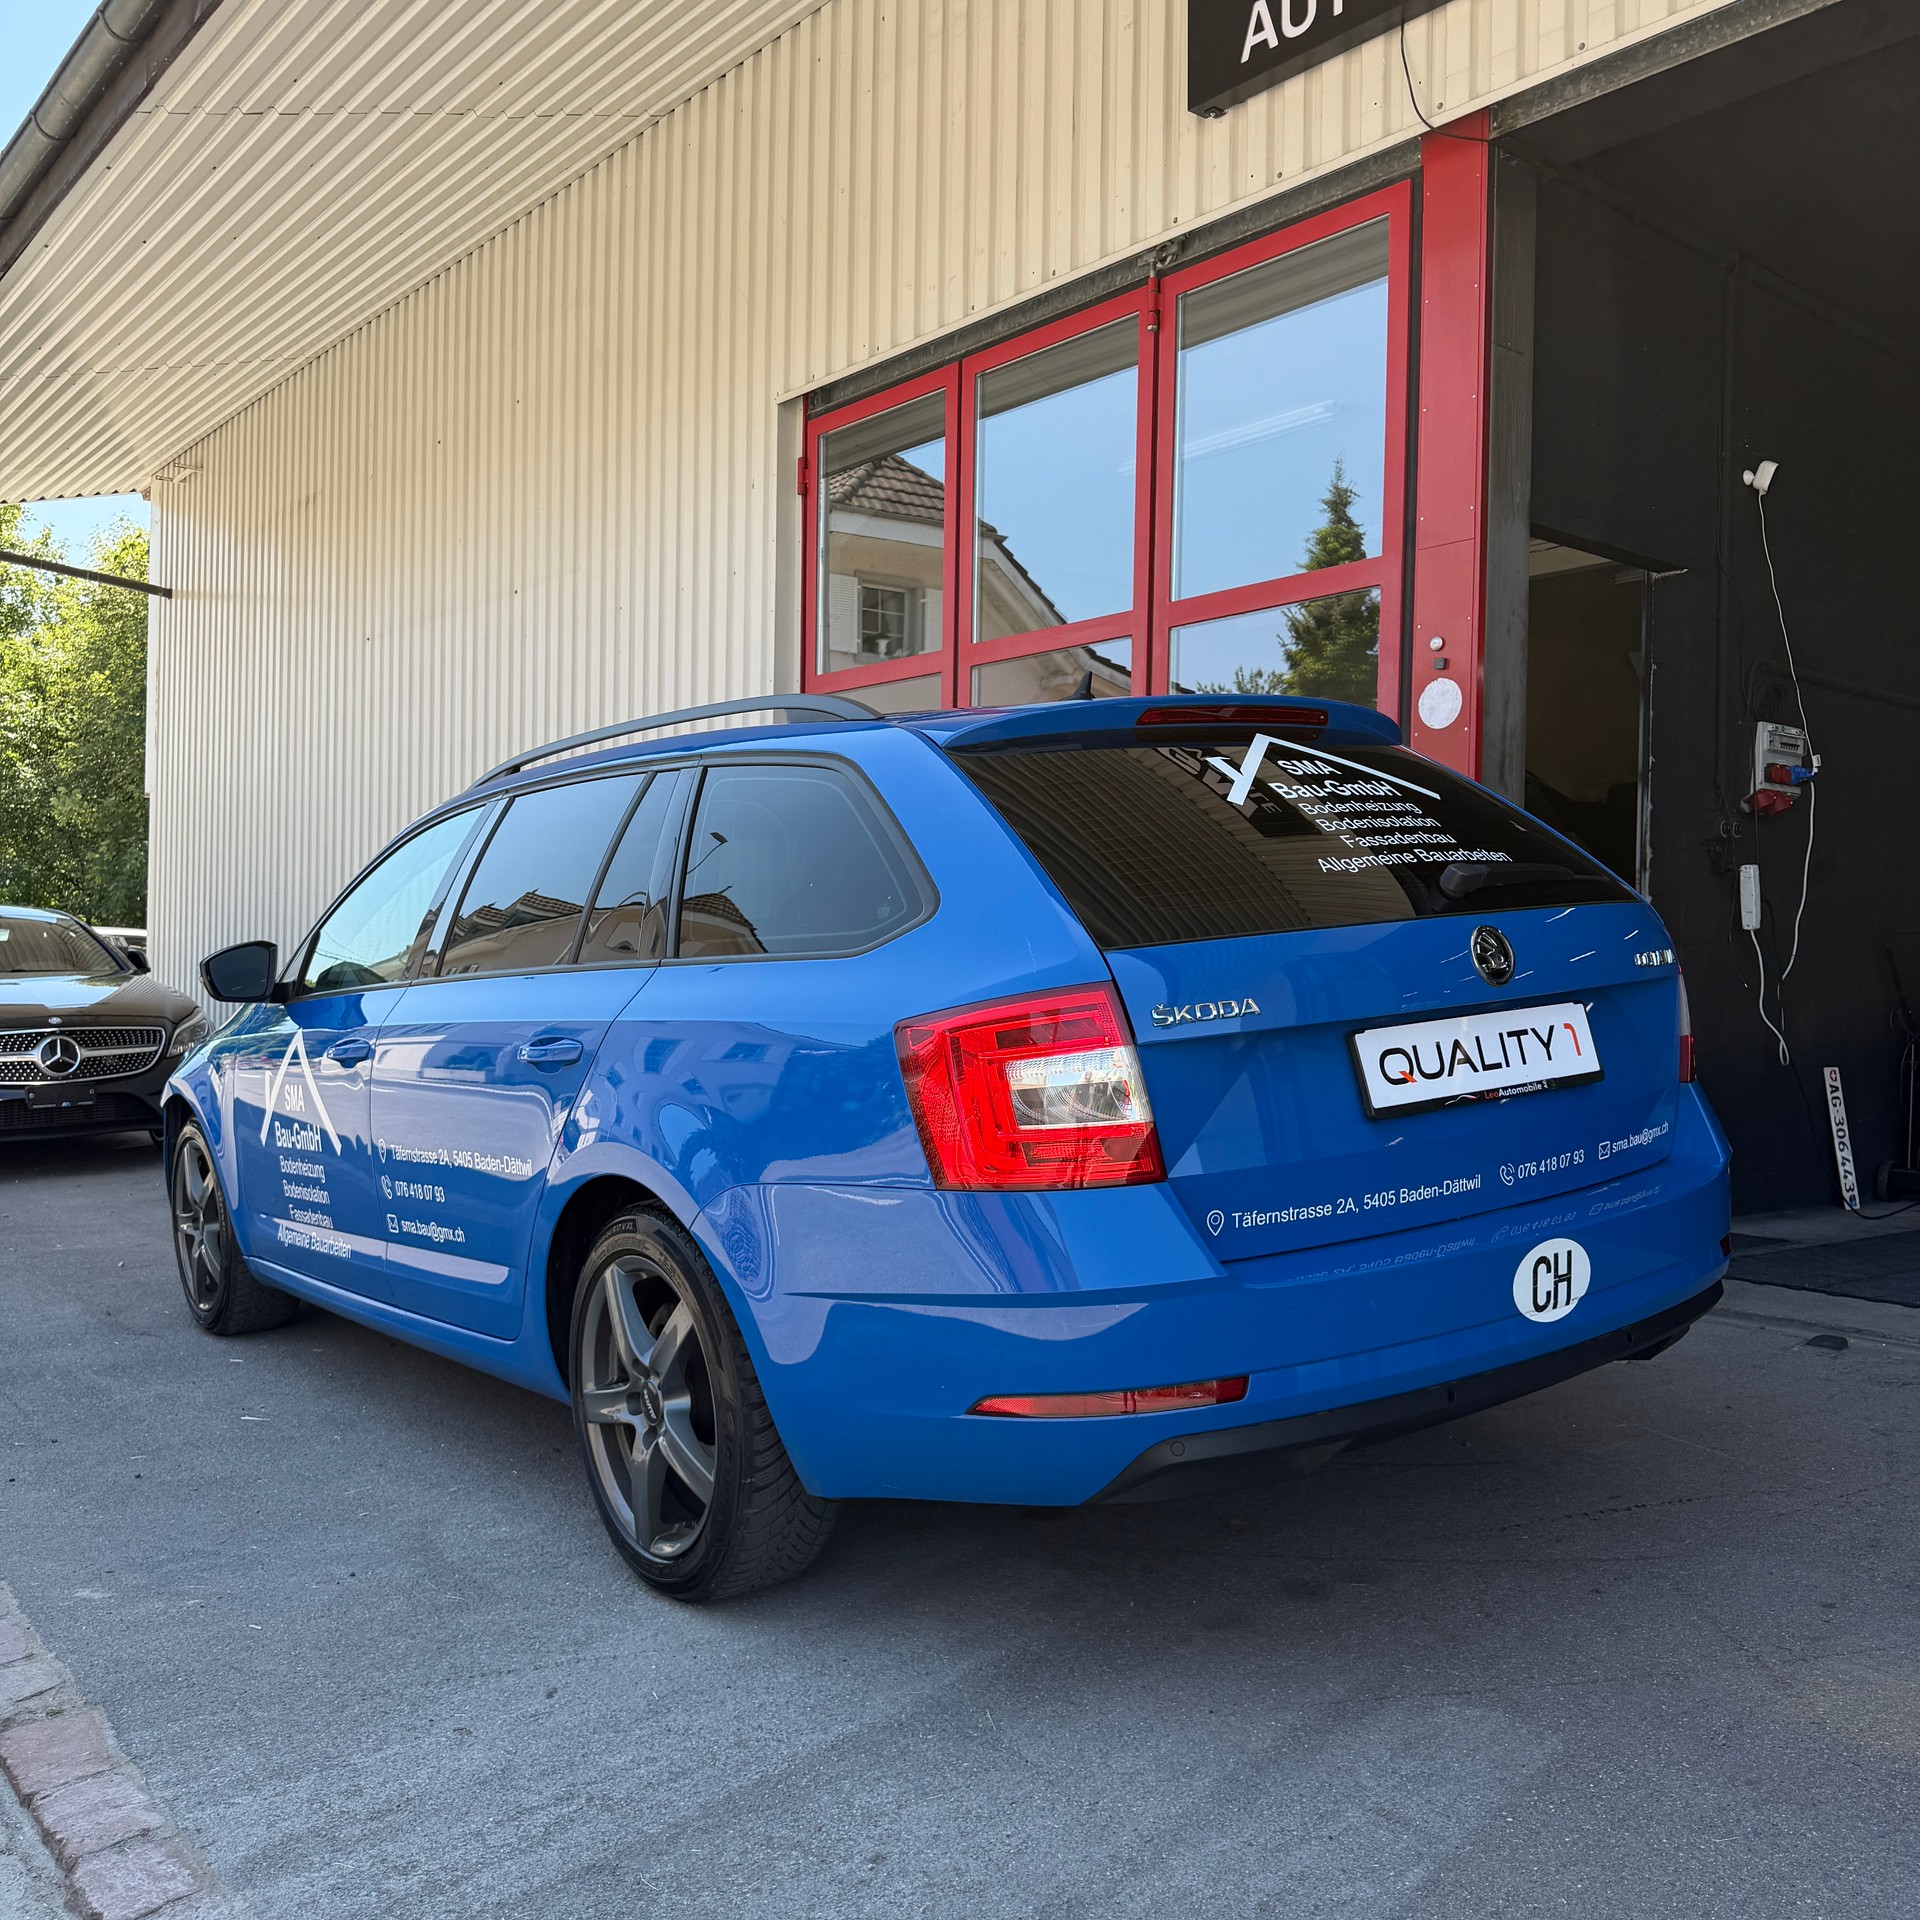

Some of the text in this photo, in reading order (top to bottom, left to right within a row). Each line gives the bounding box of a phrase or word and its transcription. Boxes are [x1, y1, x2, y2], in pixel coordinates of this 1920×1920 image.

[1240, 0, 1343, 64] AU
[1277, 760, 1342, 775] SMA
[1267, 780, 1402, 799] Bau-GmbH
[1298, 800, 1422, 815] Bodenheizung
[1315, 814, 1441, 832] Bodenisolation
[1339, 830, 1457, 848] Fassadenbau
[1317, 848, 1513, 873] Allgemeine Bauarbeiten
[1151, 998, 1261, 1026] ŠKODA
[1379, 1023, 1582, 1086] QUALITY 1
[285, 1084, 305, 1111] SMA
[275, 1121, 322, 1152] Bau-GmbH
[1612, 1120, 1669, 1153] sma.bau@gmx.ch
[280, 1155, 325, 1183] Bodenheizung
[390, 1145, 532, 1176] Täfernstrasse 2A, 5405 Baden-Dättwil
[1518, 1149, 1584, 1179] 076 418 07 93
[283, 1180, 330, 1204] Bodenisolation
[395, 1181, 445, 1202] 076 418 07 93
[1232, 1174, 1481, 1228] Täfernstrasse 2A, 5405 Baden-Dättwil
[289, 1204, 333, 1228] Fassadenbau
[278, 1224, 351, 1258] Allgemeine Bauarbeiten
[401, 1220, 465, 1242] sma.bau@gmx.ch
[1533, 1249, 1572, 1313] CH
